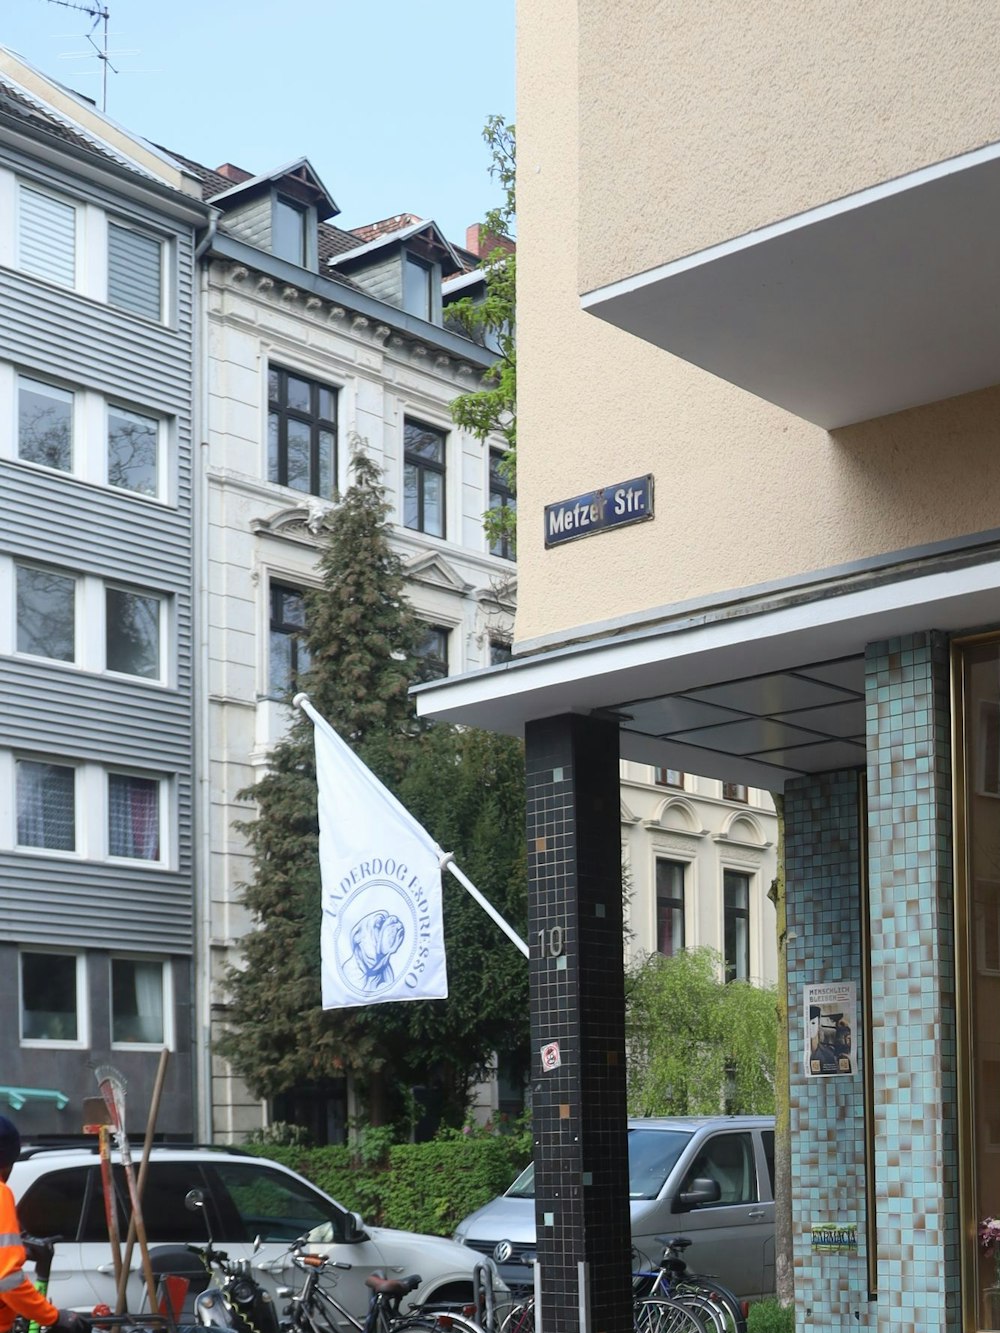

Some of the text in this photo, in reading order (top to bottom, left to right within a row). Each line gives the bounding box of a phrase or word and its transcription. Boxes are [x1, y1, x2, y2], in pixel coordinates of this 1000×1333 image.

[549, 487, 645, 536] Metzer Str.
[325, 858, 408, 918] UNDERDOG
[538, 926, 563, 958] 10
